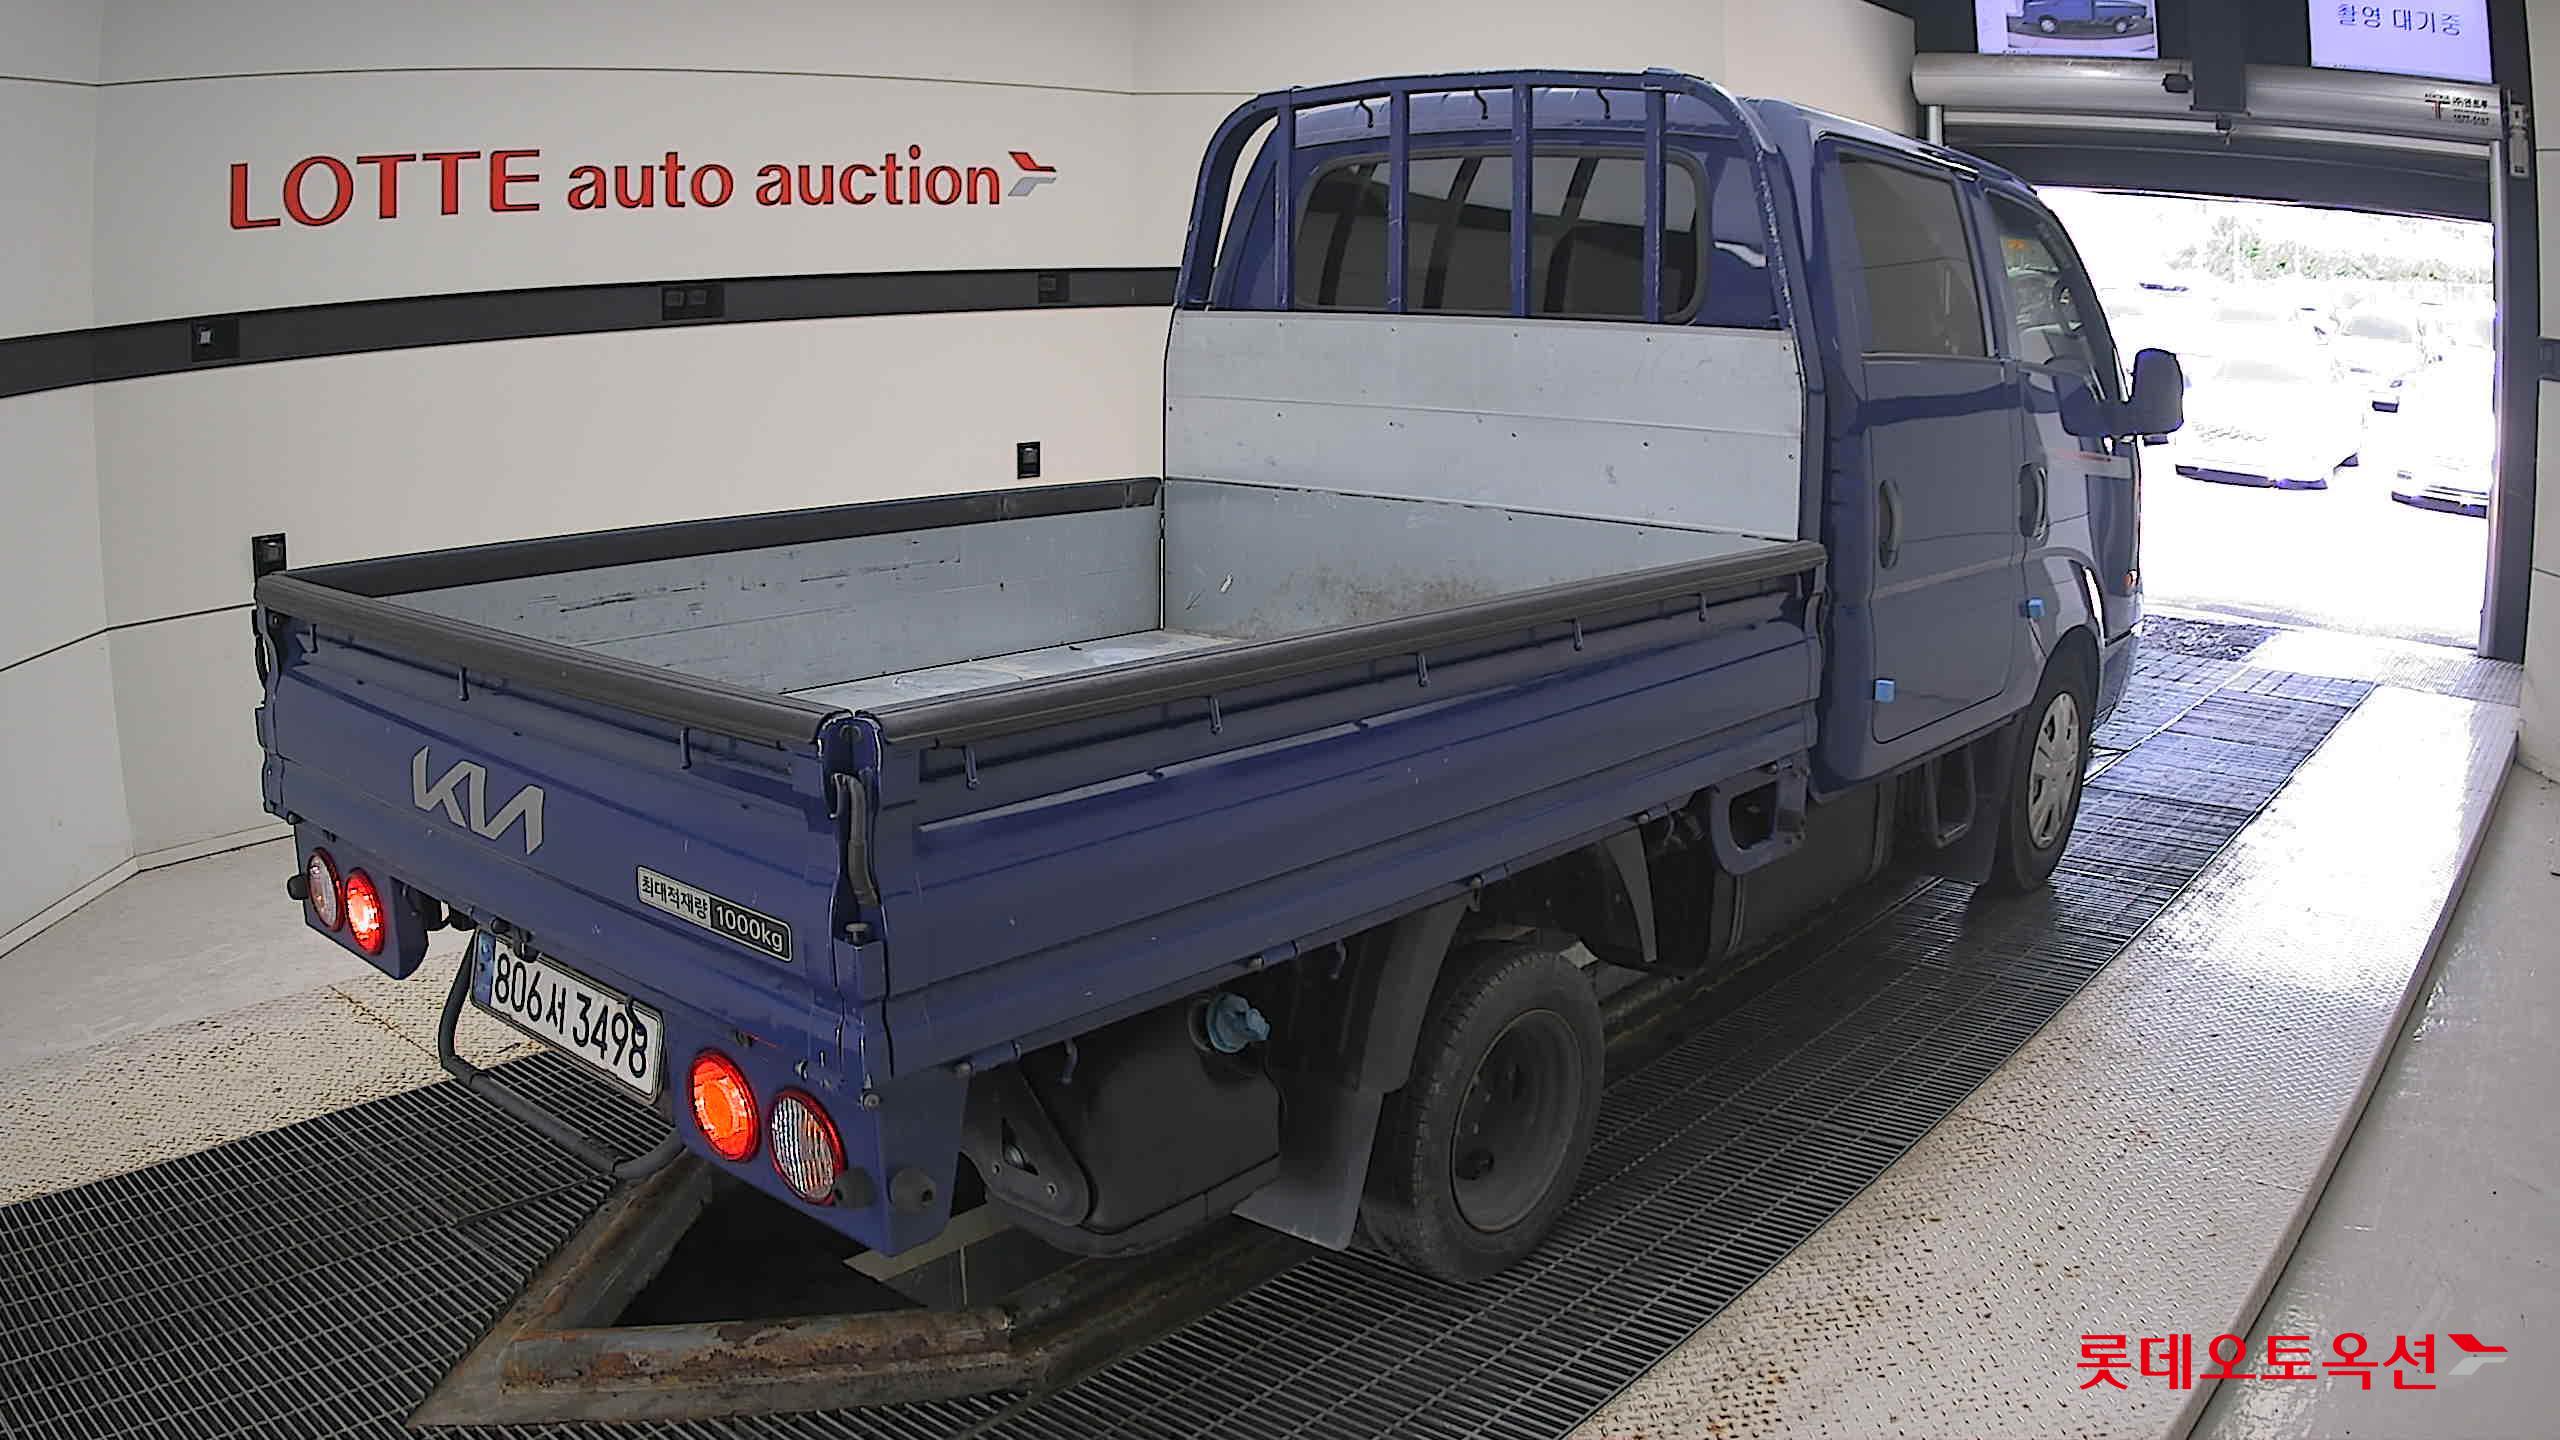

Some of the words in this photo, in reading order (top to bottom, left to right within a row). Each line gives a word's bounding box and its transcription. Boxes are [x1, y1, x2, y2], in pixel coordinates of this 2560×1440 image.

[2392, 8, 2461, 36] 대기중
[229, 149, 541, 230] LOTTE
[567, 151, 736, 209] auto
[755, 144, 1002, 207] auction
[411, 745, 545, 855] KIA
[642, 875, 708, 919] 최대적재량
[715, 905, 783, 952] 1000kg
[494, 953, 567, 1035] 806서
[572, 991, 649, 1079] 3498
